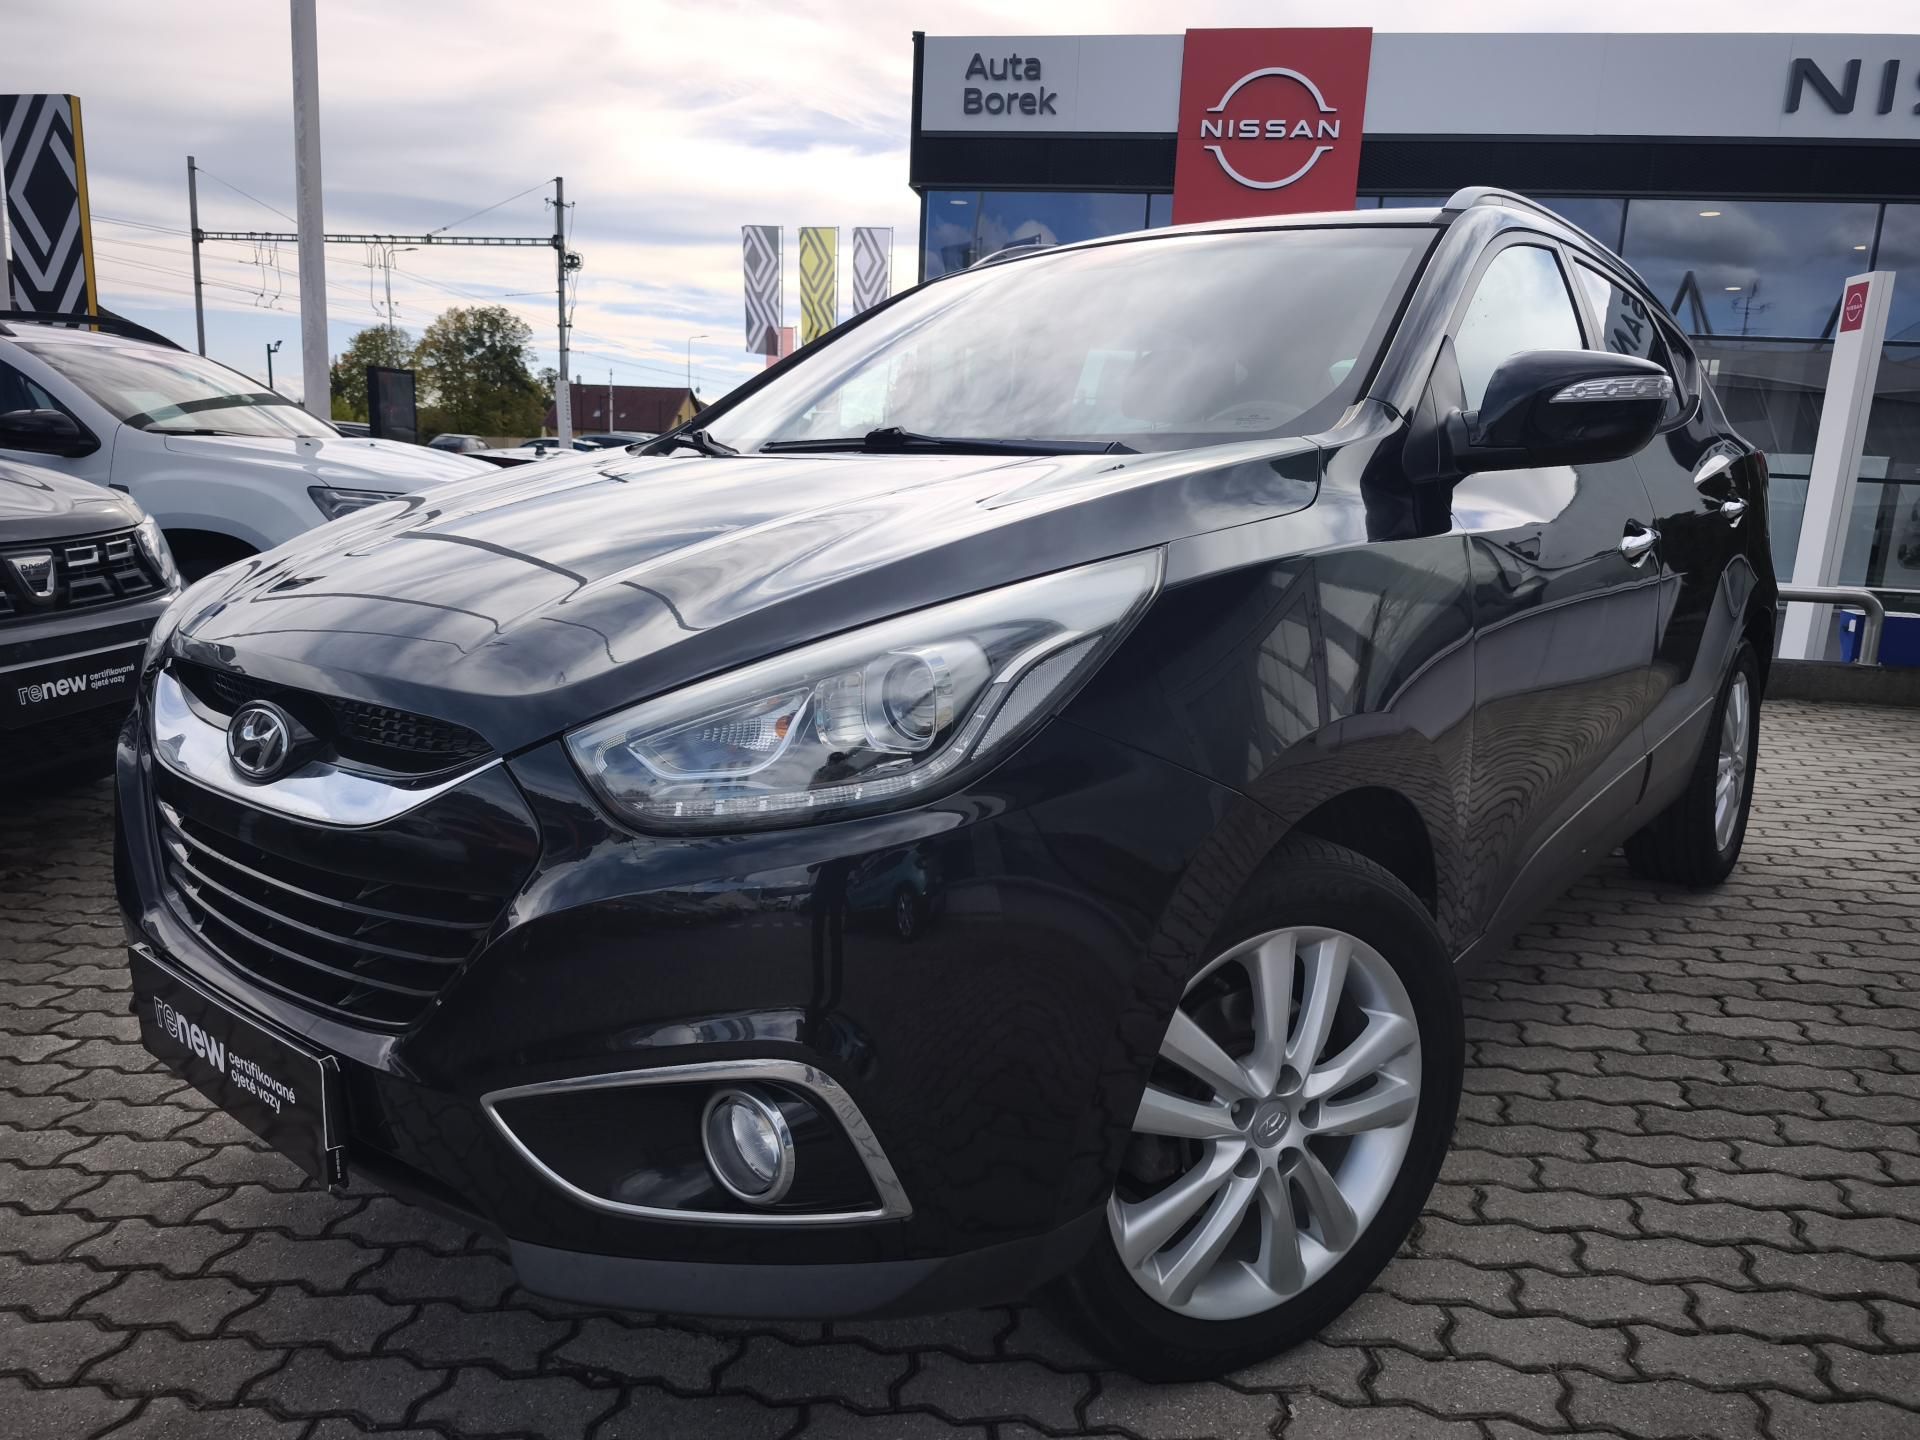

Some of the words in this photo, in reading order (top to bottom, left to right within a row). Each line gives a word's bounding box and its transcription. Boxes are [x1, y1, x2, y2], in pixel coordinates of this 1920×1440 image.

[965, 52, 1041, 81] Auta
[963, 86, 1057, 115] Borek
[1784, 57, 1920, 115] NI
[1200, 119, 1341, 139] NISSAN
[18, 674, 87, 705] renew
[89, 663, 135, 681] certifikované
[91, 679, 109, 689] ojeté
[109, 674, 126, 684] vozy
[154, 996, 225, 1074] renew
[228, 1051, 296, 1104] certifikované
[231, 1068, 256, 1096] ojeté
[256, 1085, 281, 1114] vozy
